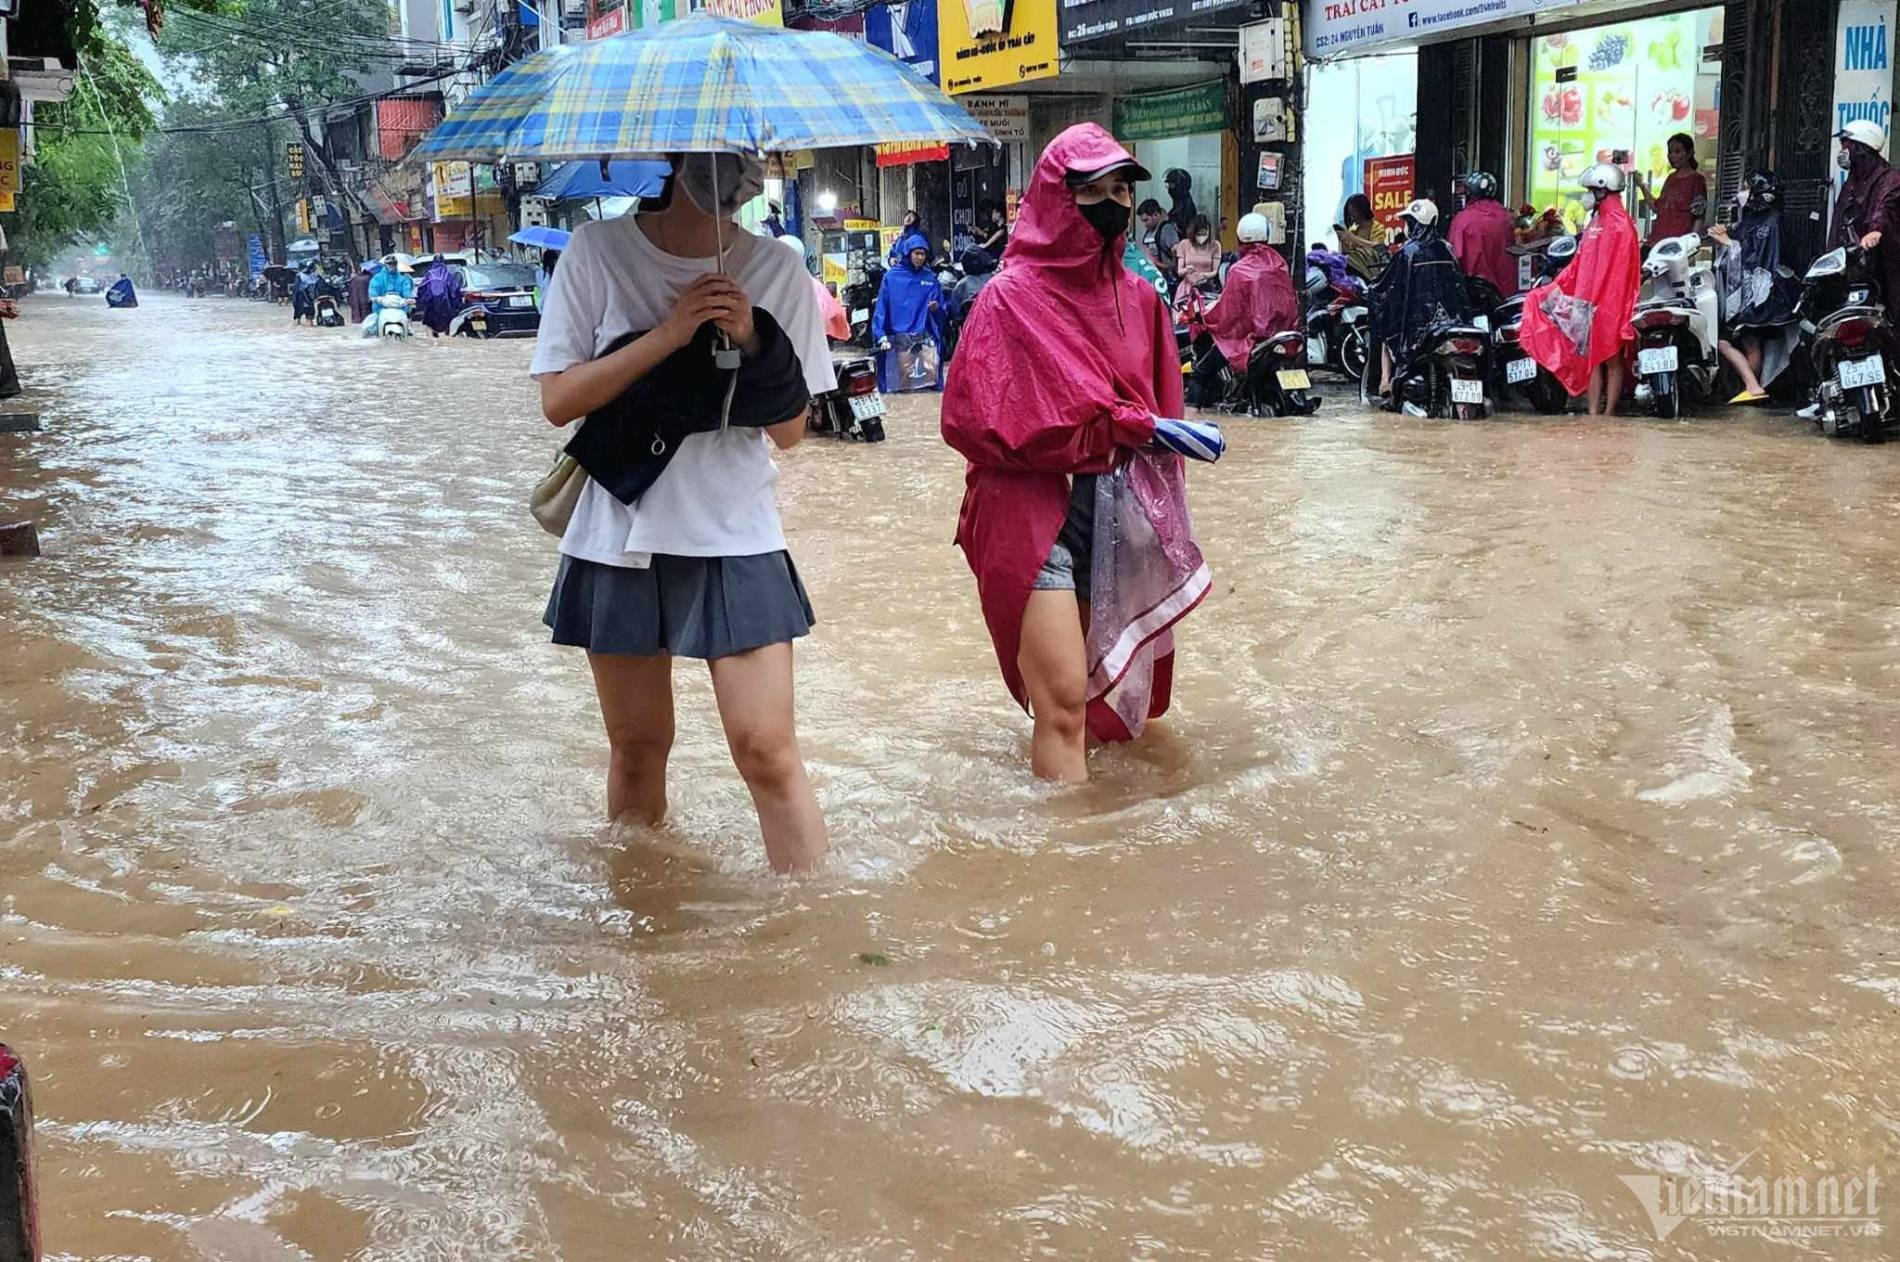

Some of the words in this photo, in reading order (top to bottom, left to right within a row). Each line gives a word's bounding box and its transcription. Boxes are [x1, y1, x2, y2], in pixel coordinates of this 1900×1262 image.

[1077, 23, 1086, 37] 26
[1845, 15, 1887, 70] NHÀ
[1375, 190, 1412, 210] SALE
